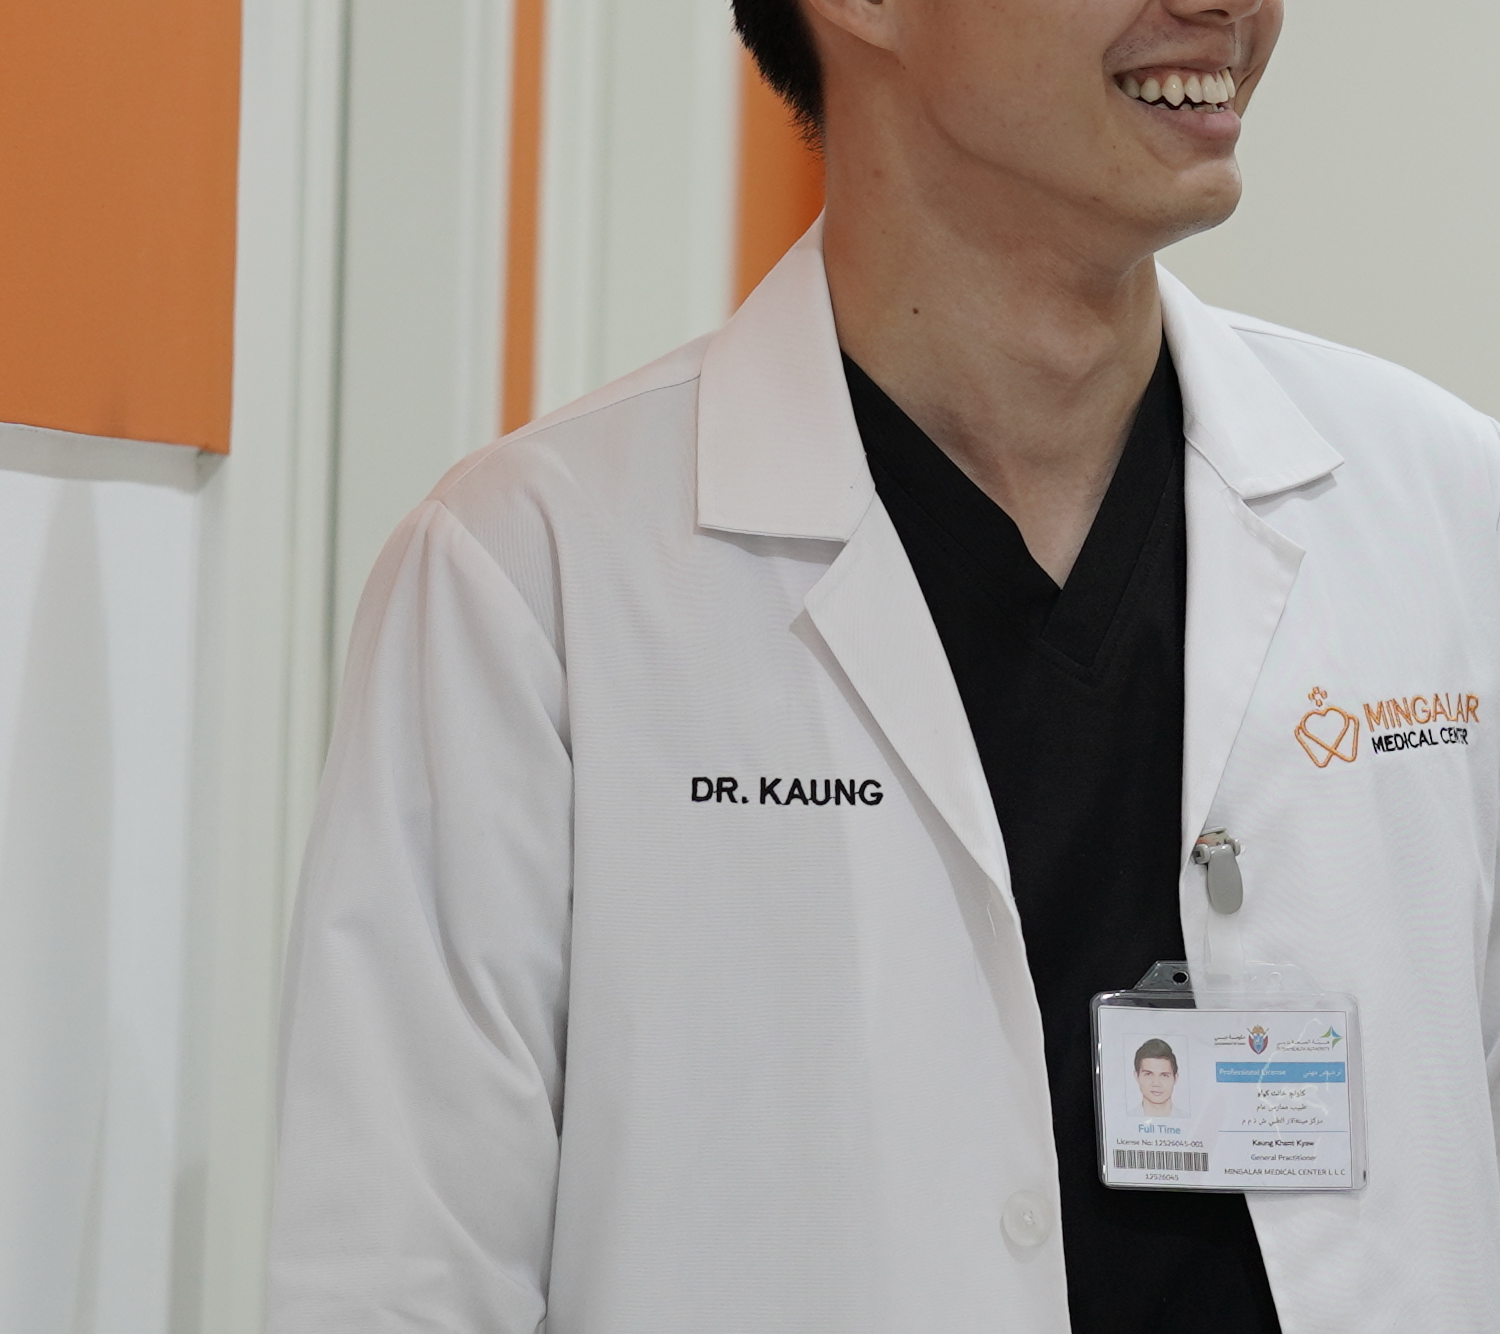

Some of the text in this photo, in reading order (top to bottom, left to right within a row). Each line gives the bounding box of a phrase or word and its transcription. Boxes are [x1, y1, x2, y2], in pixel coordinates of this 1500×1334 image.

[1363, 692, 1480, 732] MINGALAR
[1371, 728, 1439, 754] MEDICAL
[691, 776, 884, 806] DR. KAUNG
[1219, 1068, 1261, 1076] Professional
[1138, 1124, 1182, 1135] Full Time
[1116, 1138, 1139, 1146] License
[1252, 1139, 1274, 1148] Kaung
[1278, 1154, 1318, 1162] Practitioner
[1224, 1168, 1262, 1176] MINGALAR
[1264, 1168, 1296, 1176] MEDICAL
[1297, 1168, 1327, 1176] CENTER
